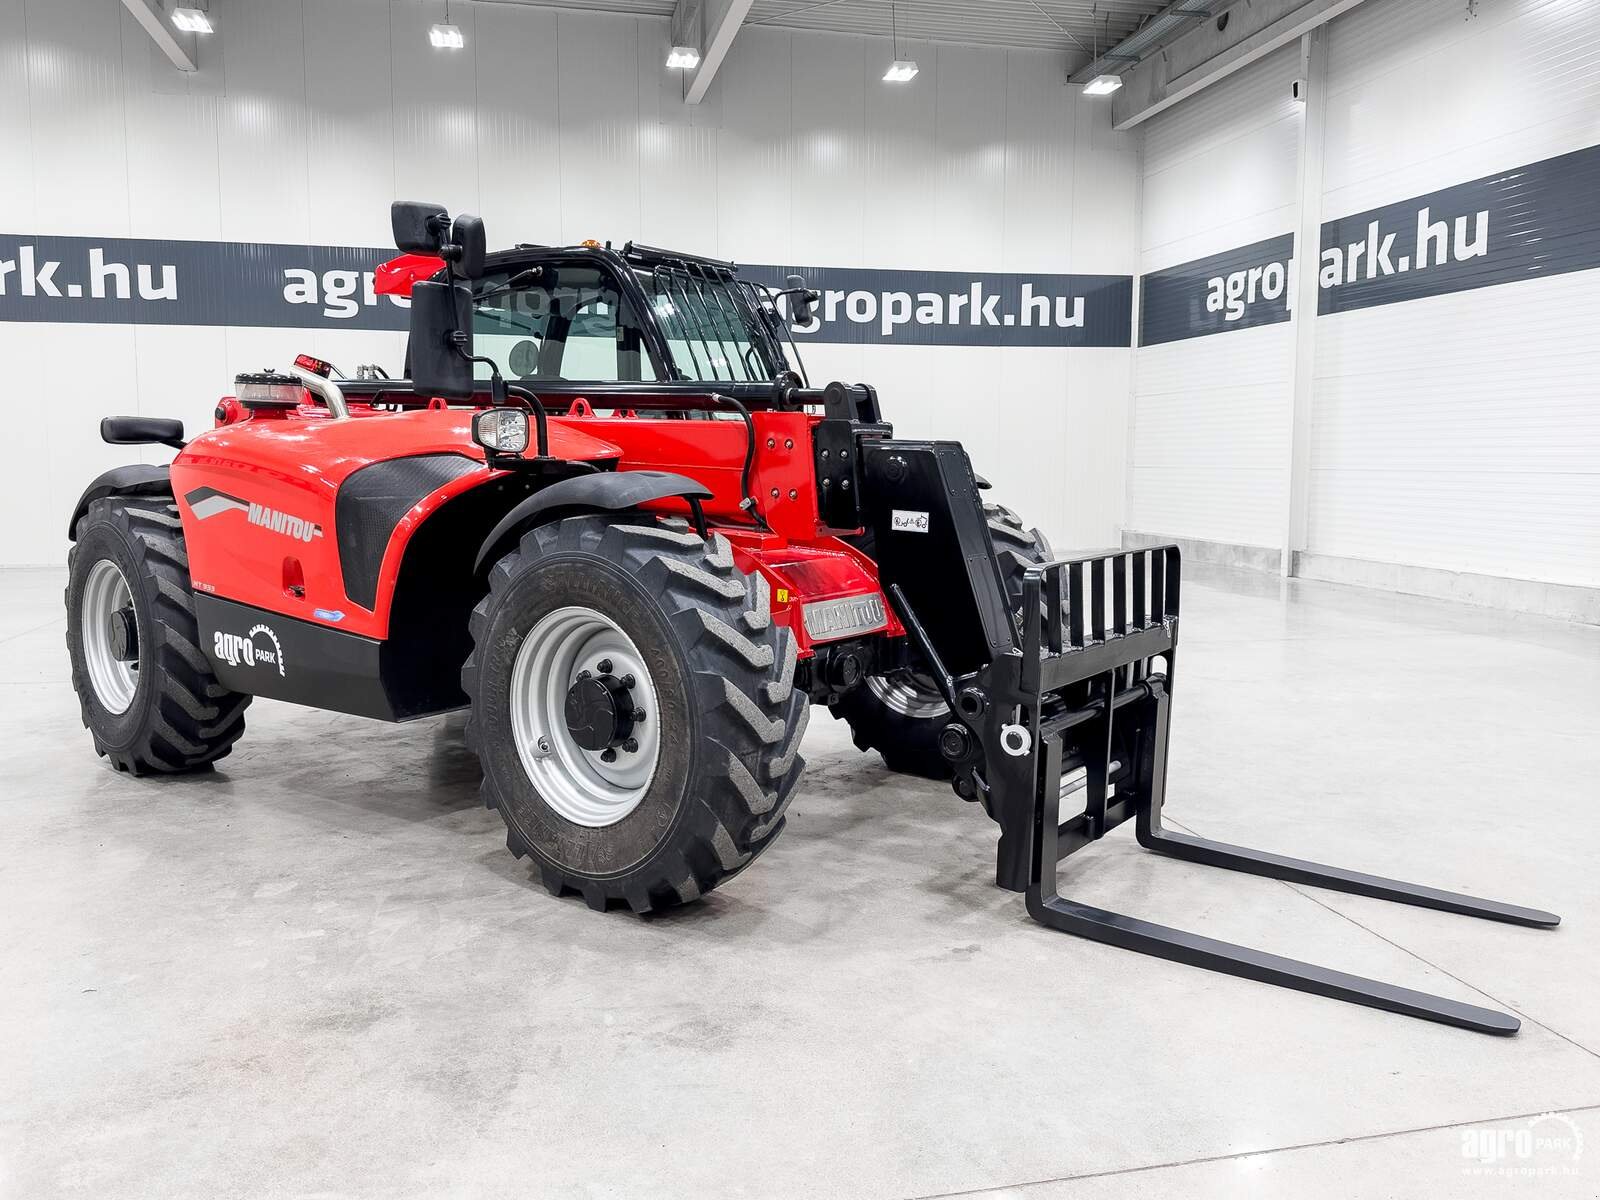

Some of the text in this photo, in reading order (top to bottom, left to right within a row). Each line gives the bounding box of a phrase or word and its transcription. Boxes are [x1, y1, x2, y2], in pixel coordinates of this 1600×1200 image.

[248, 502, 316, 543] MANITOU
[806, 599, 884, 635] MANITOU
[214, 631, 276, 666] agro PARK
